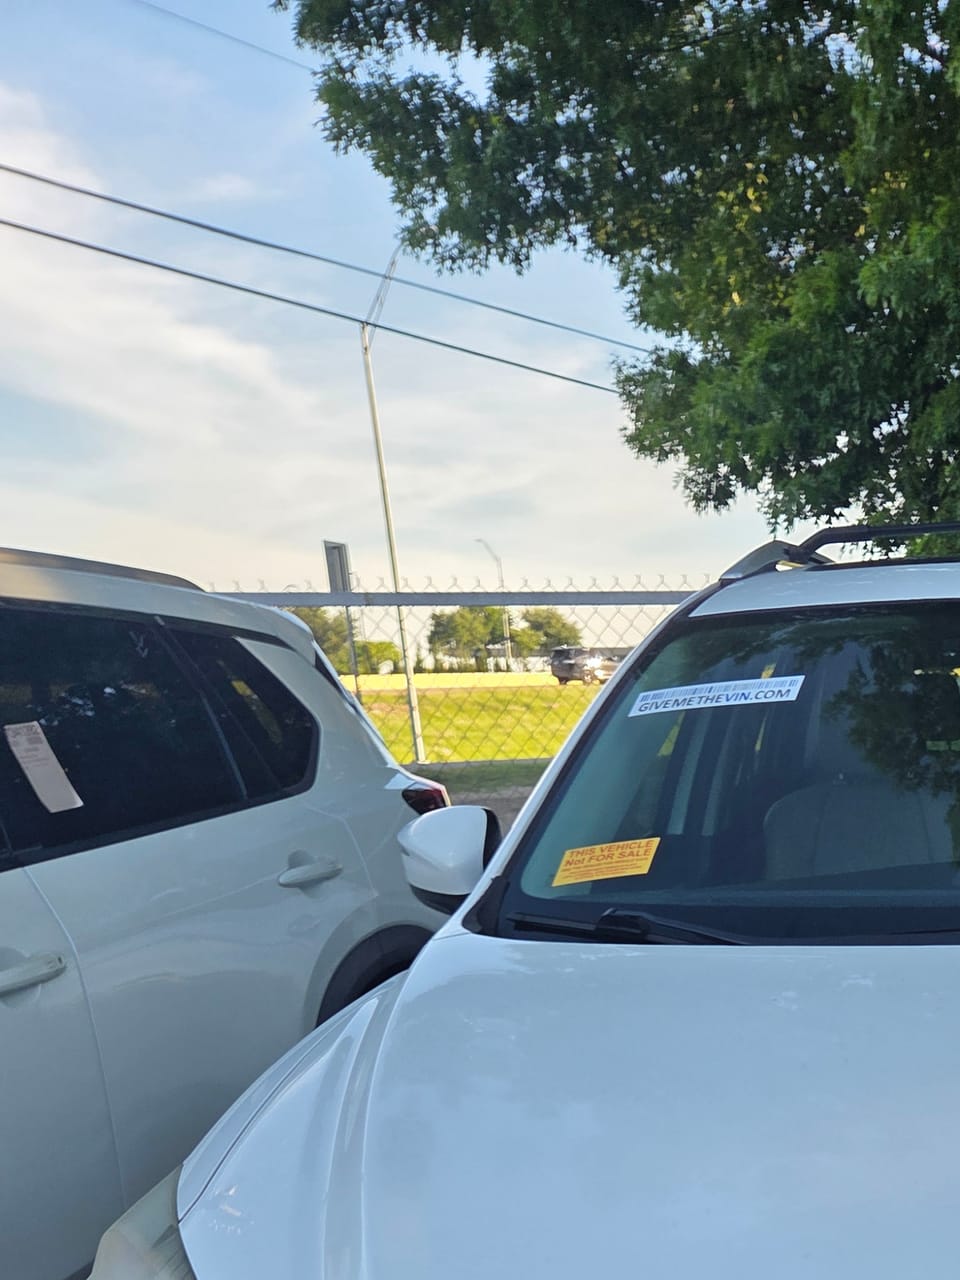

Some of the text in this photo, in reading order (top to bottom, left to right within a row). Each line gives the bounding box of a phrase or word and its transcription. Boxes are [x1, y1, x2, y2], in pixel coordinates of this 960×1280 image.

[638, 688, 792, 712] GIVEMETHEVIN.COM
[570, 840, 654, 858] THIS VEHICLE
[588, 853, 614, 863] FOR
[618, 847, 652, 859] SALE
